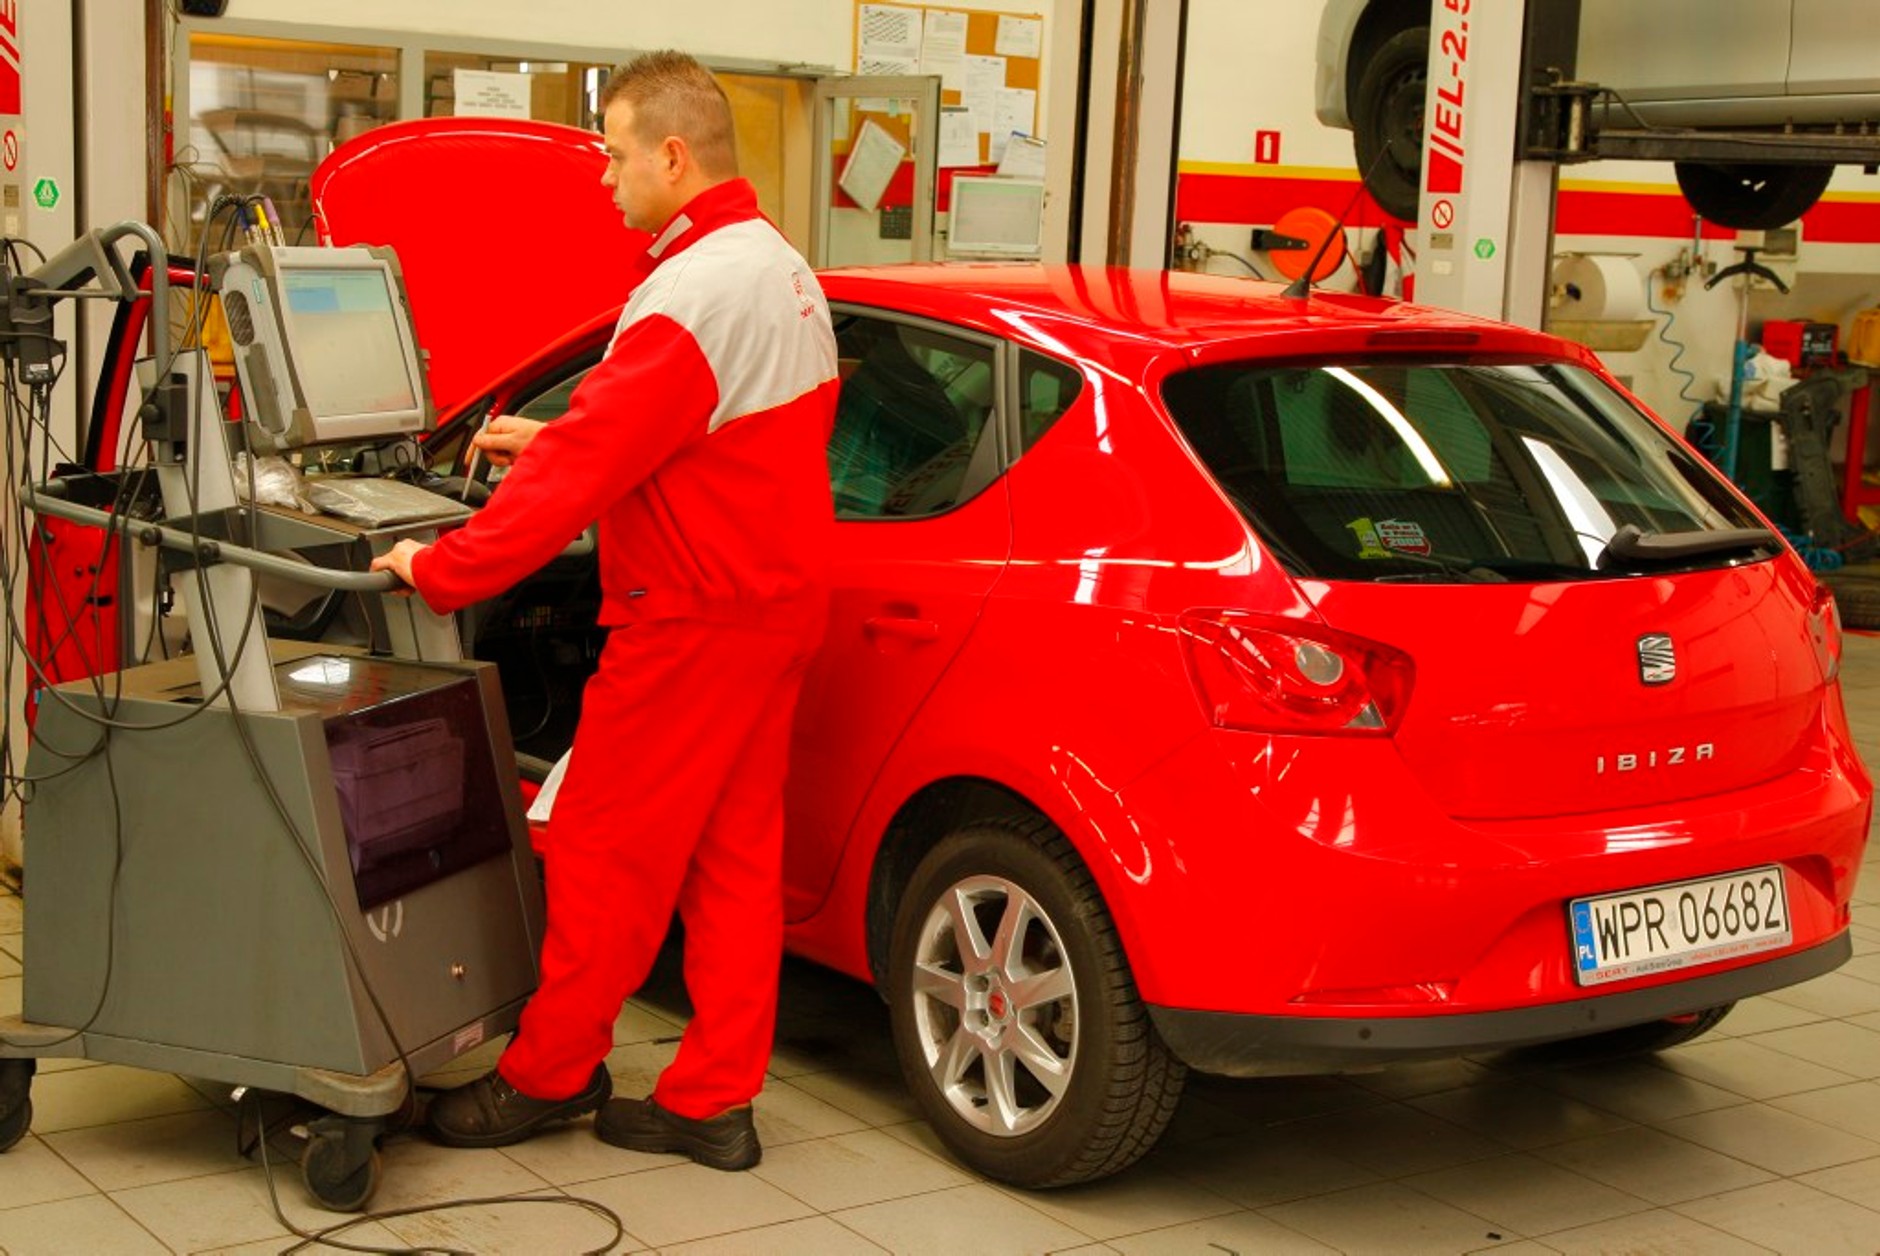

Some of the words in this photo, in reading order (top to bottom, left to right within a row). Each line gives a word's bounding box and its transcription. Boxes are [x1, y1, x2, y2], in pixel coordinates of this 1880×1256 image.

[1597, 743, 1714, 774] IBIZA
[1595, 897, 1670, 961] WPR
[1679, 877, 1781, 944] 06682
[1579, 944, 1594, 960] PL
